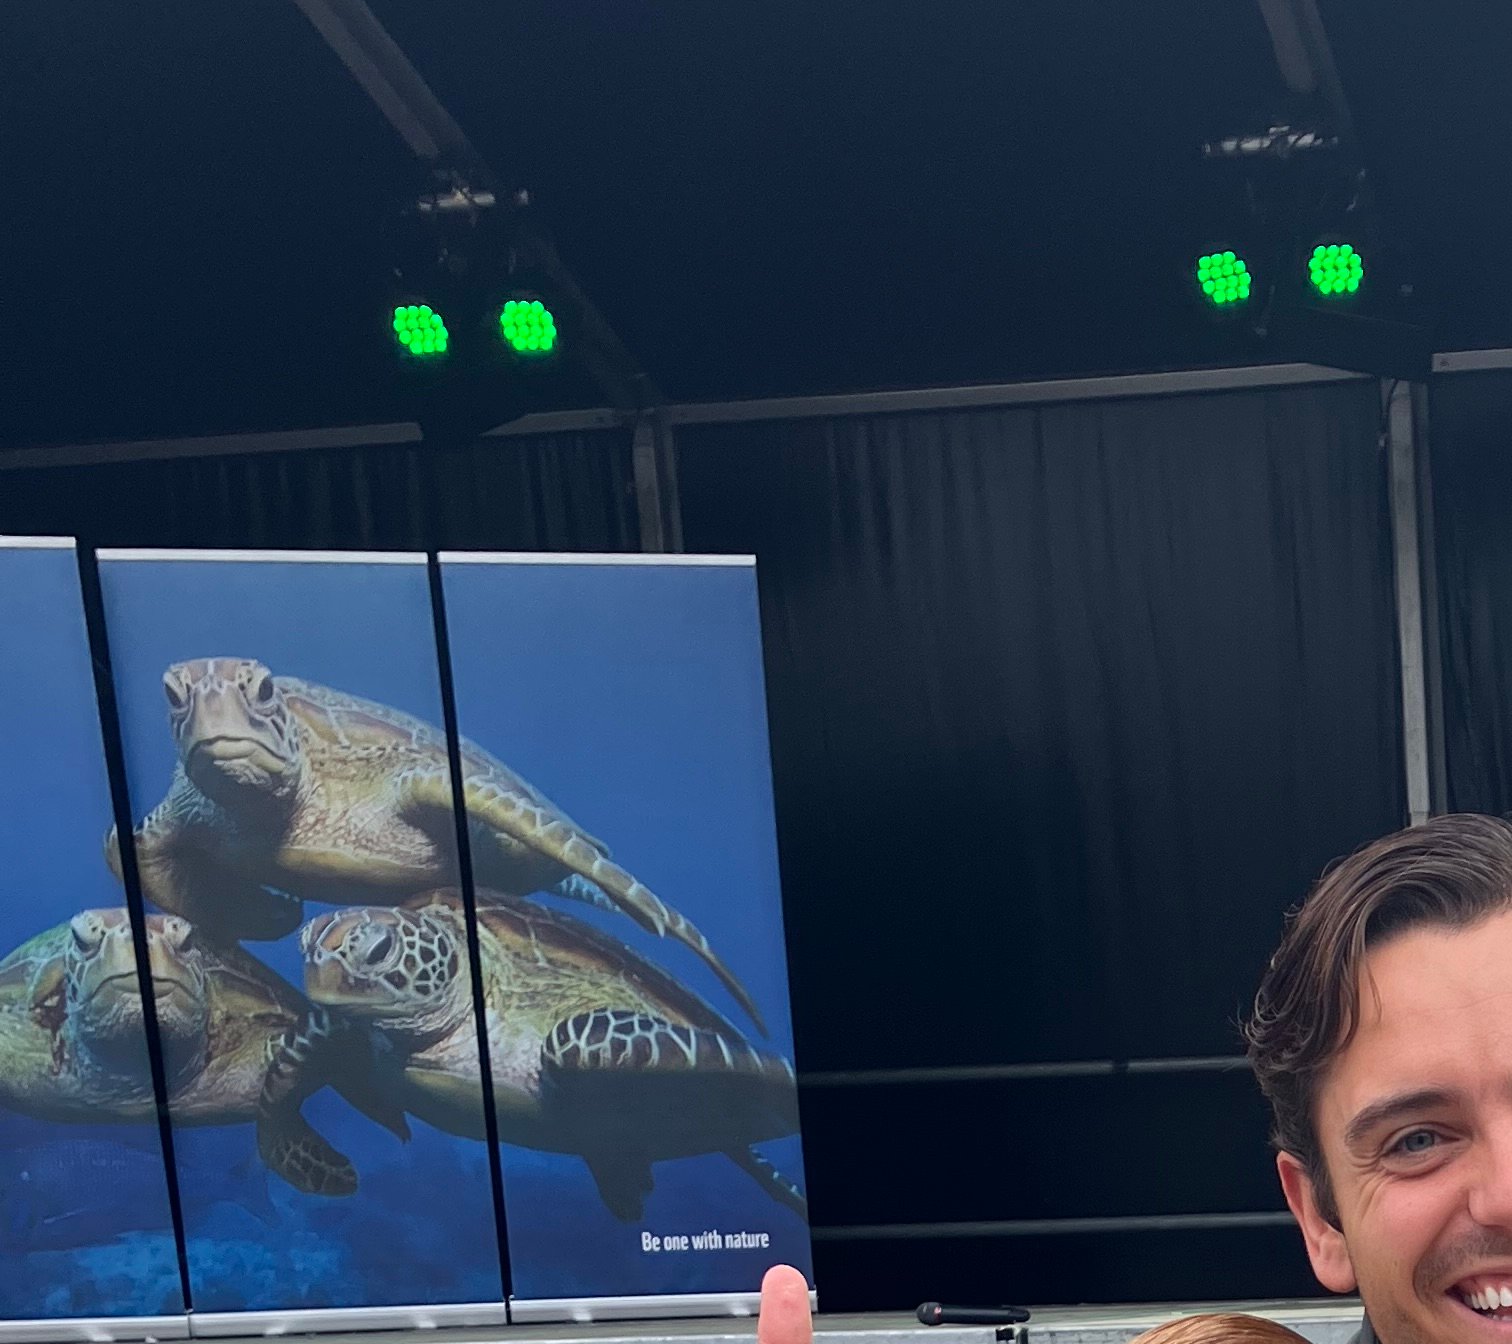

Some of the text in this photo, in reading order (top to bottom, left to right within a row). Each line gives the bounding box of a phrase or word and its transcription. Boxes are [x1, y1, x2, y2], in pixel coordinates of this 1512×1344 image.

[641, 1229, 770, 1251] Be one with nature
